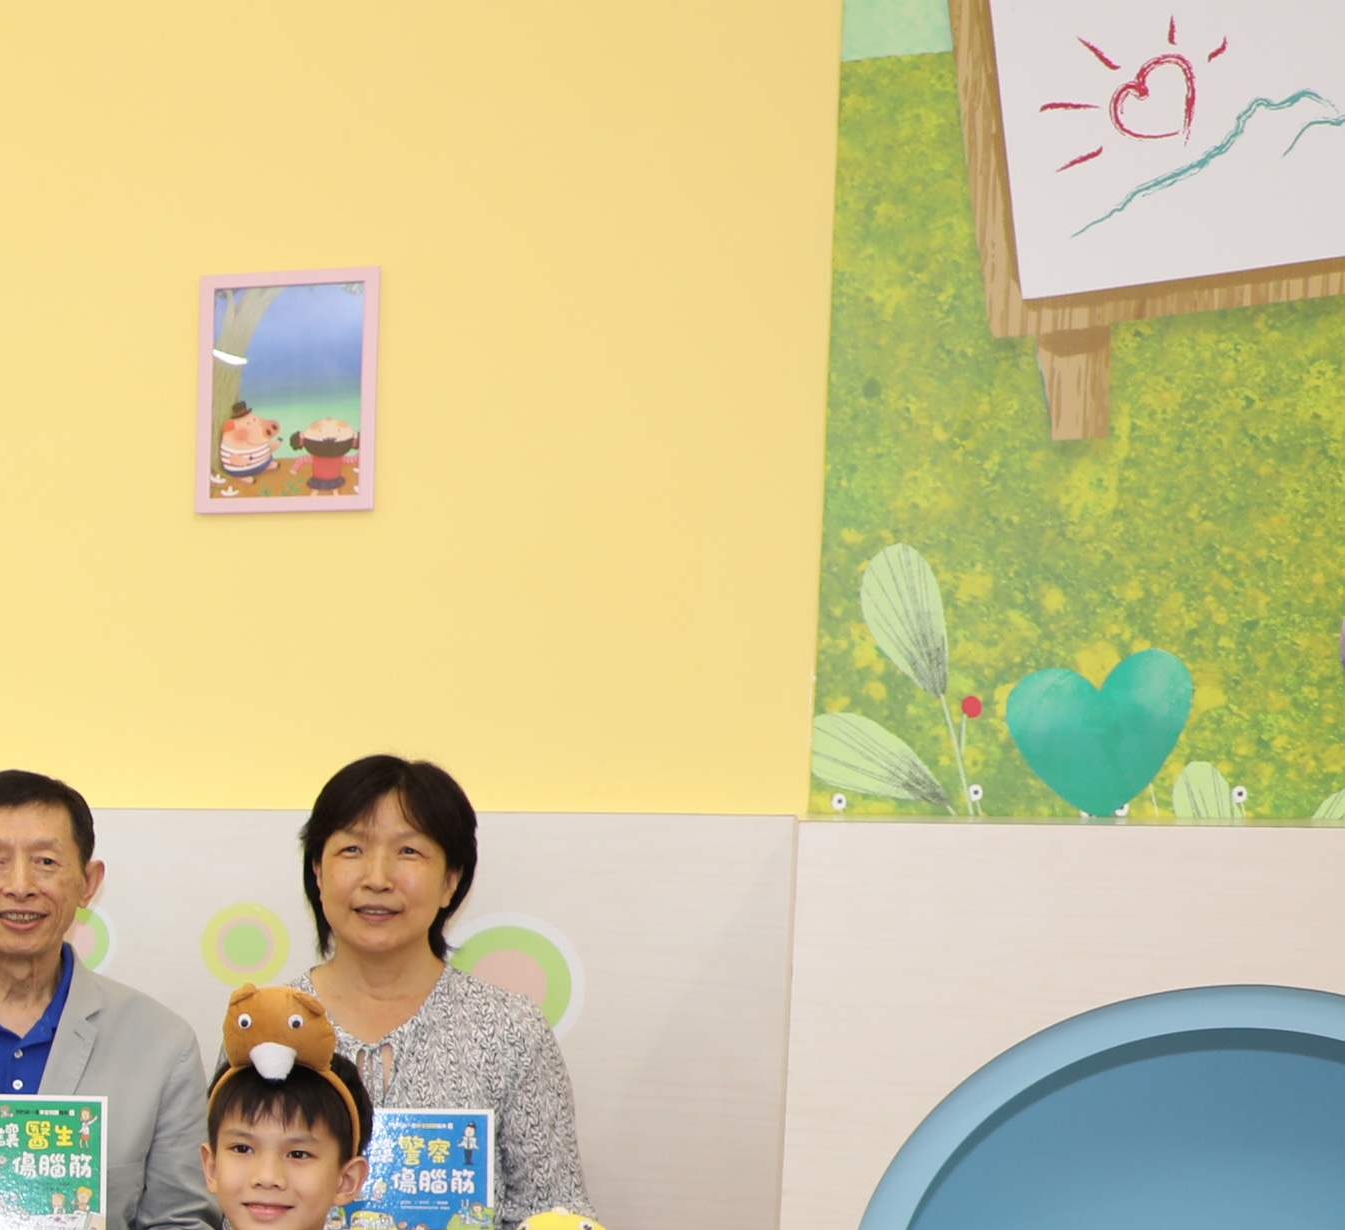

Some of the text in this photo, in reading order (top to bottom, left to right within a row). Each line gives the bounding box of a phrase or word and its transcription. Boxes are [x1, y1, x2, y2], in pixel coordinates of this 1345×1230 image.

[12, 1151, 92, 1178] 傷腦筋
[391, 1167, 475, 1195] 傷腦筋
